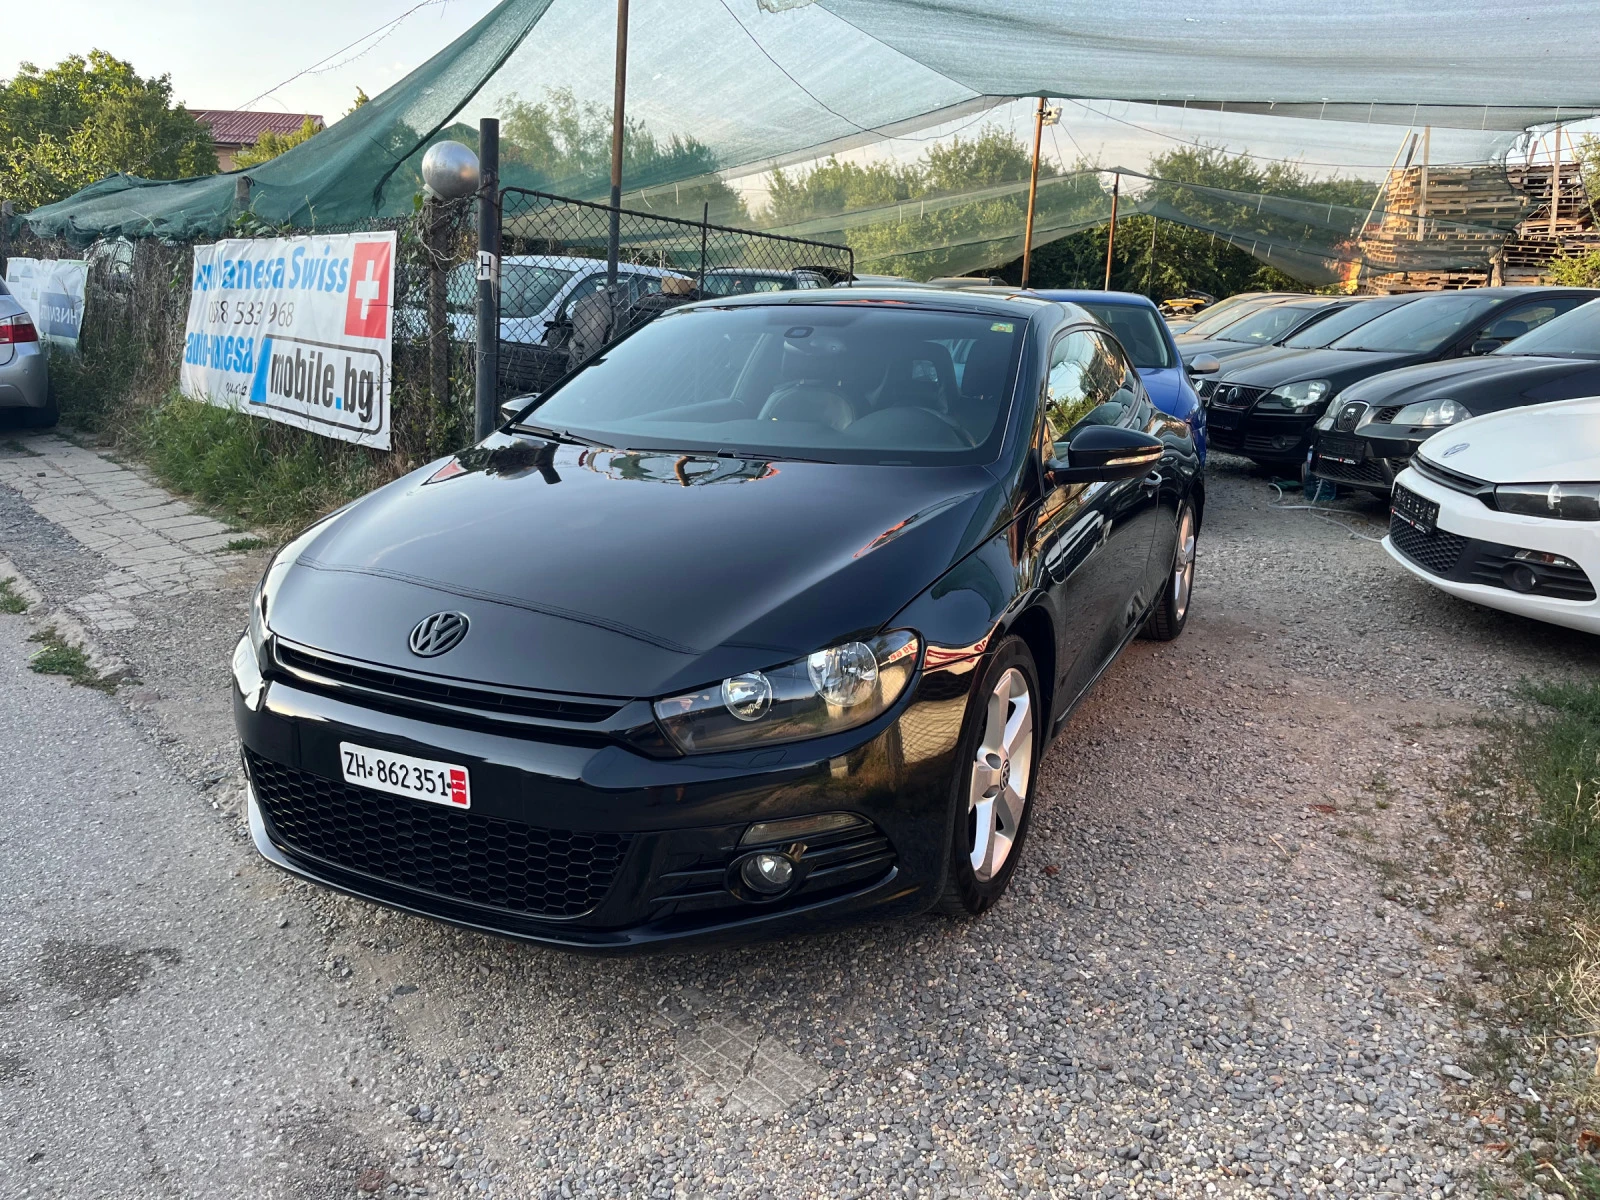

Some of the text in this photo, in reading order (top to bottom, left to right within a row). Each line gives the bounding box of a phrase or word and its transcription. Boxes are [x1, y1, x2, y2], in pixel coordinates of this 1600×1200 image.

[288, 245, 350, 294] Swiss
[268, 301, 295, 328] 968
[270, 348, 374, 423] mobile.bg
